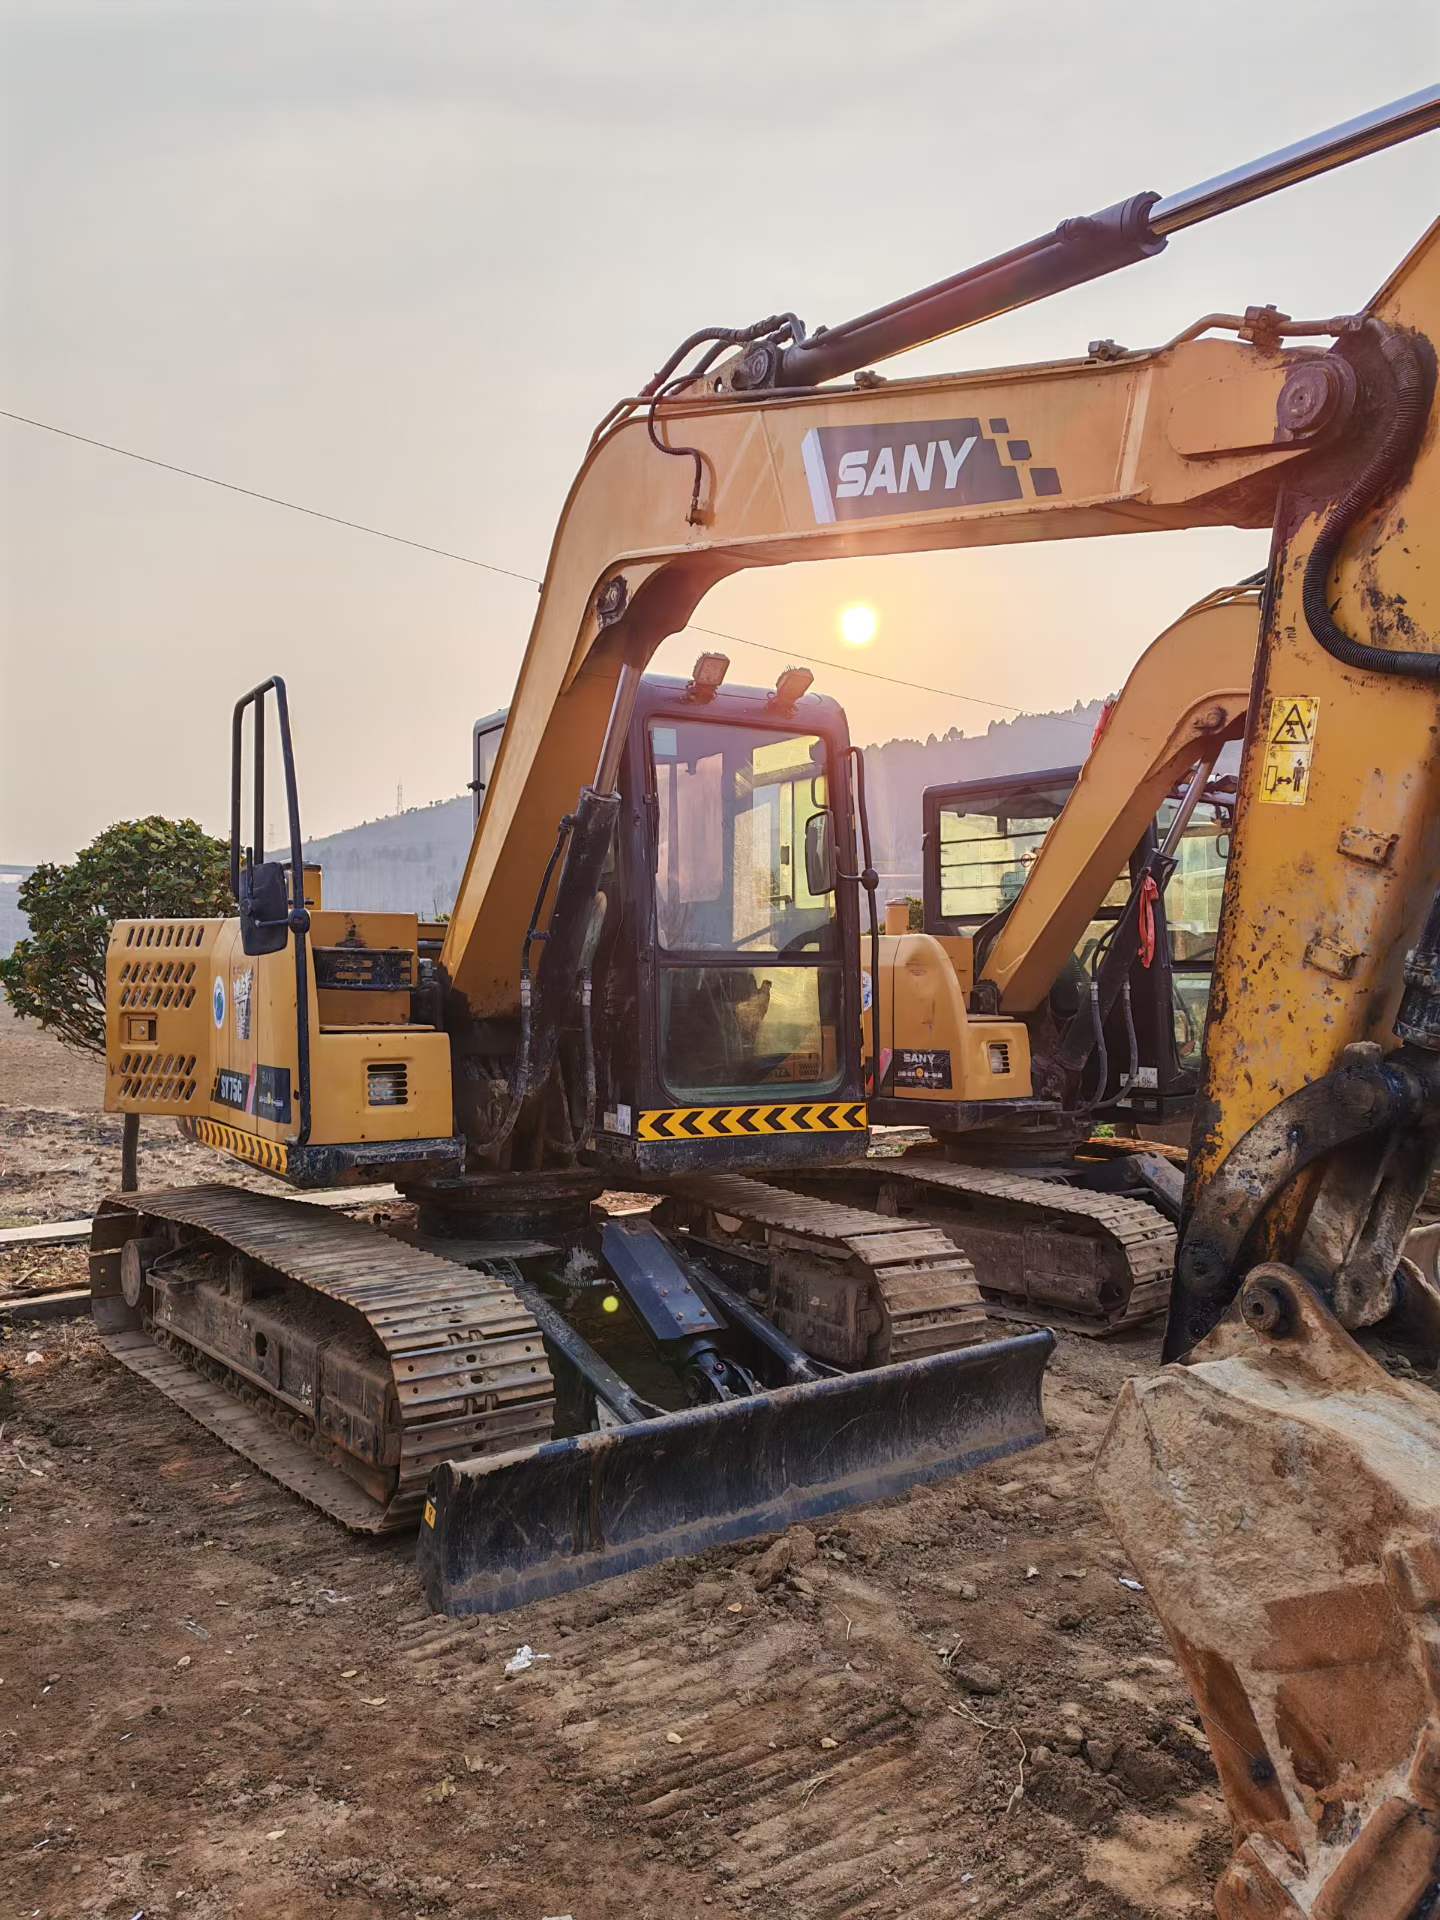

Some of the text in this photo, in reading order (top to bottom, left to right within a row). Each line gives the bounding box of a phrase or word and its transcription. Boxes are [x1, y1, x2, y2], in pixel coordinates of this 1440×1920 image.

[836, 436, 978, 498] SANY
[903, 1053, 935, 1064] SANY
[221, 1075, 242, 1103] SY75C
